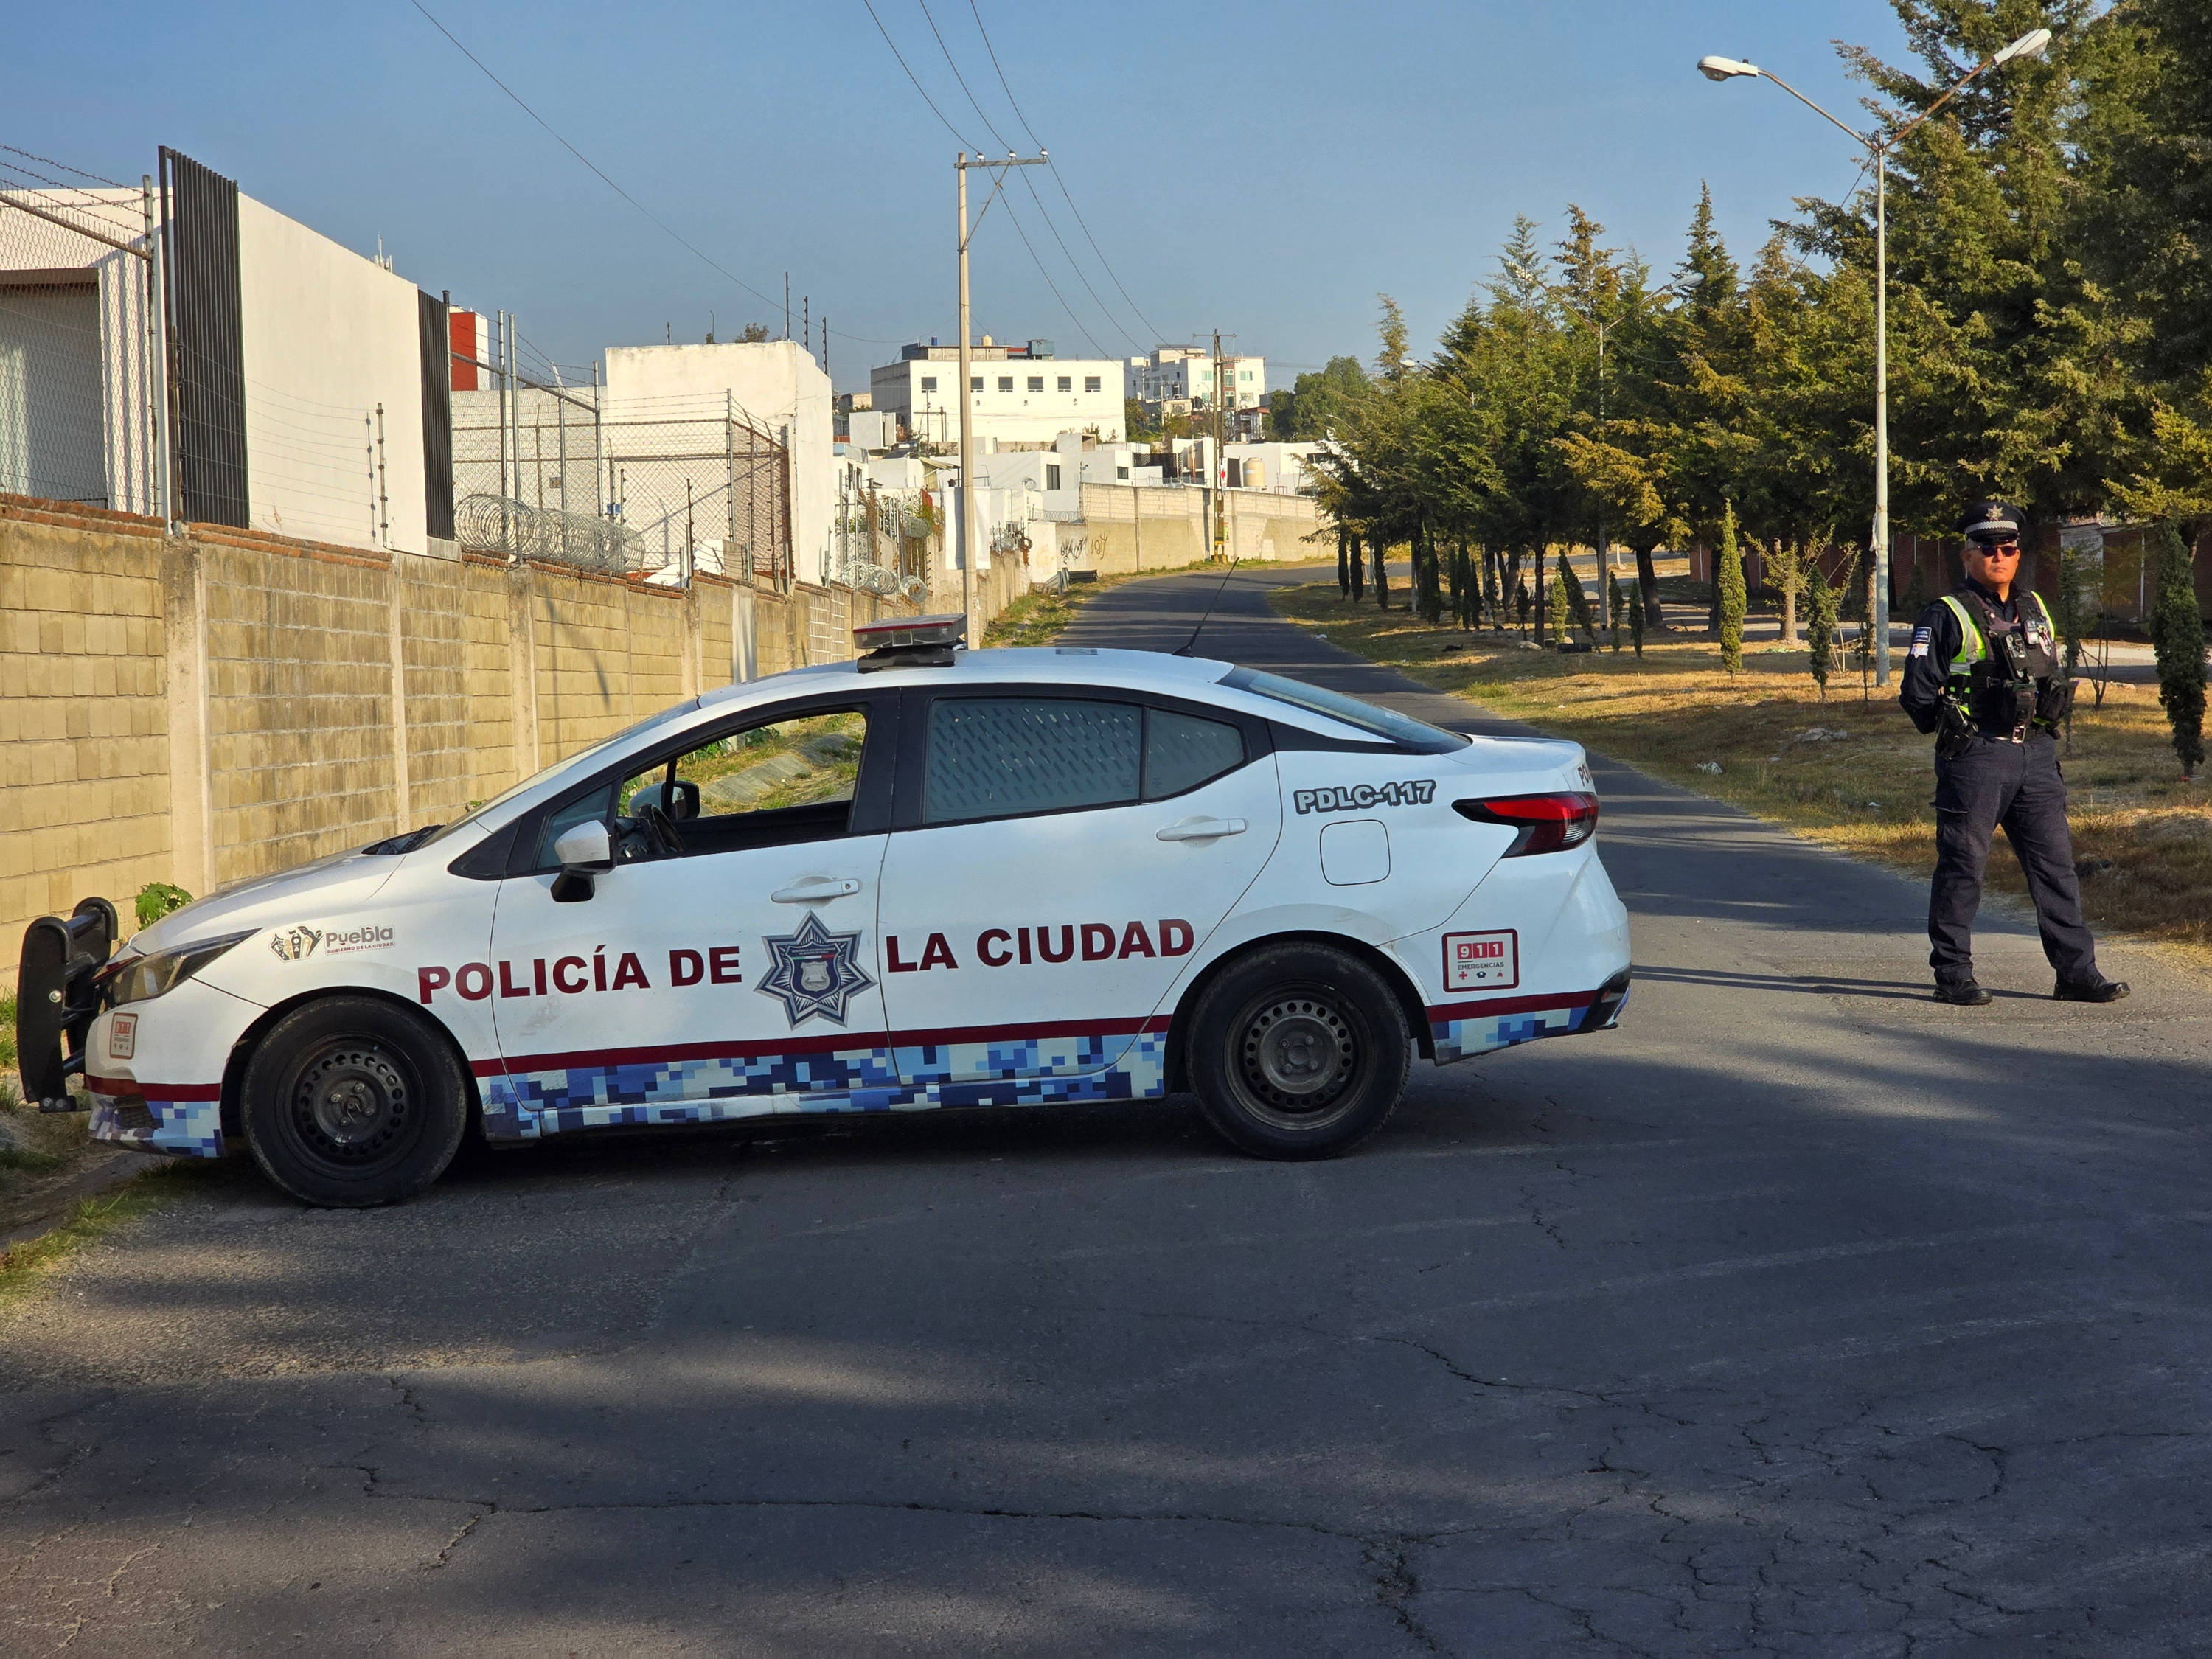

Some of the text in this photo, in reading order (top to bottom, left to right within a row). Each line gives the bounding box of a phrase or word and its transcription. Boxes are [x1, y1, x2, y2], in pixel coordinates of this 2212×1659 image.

[1293, 779, 1437, 815] PDLC-117
[325, 925, 394, 947] Puebla
[327, 946, 355, 954] GOBIERNO
[1459, 943, 1501, 959] 911
[417, 919, 1194, 1005] POLICÍA DE LA CIUDAD
[1457, 961, 1505, 970] EMERGENCIAS
